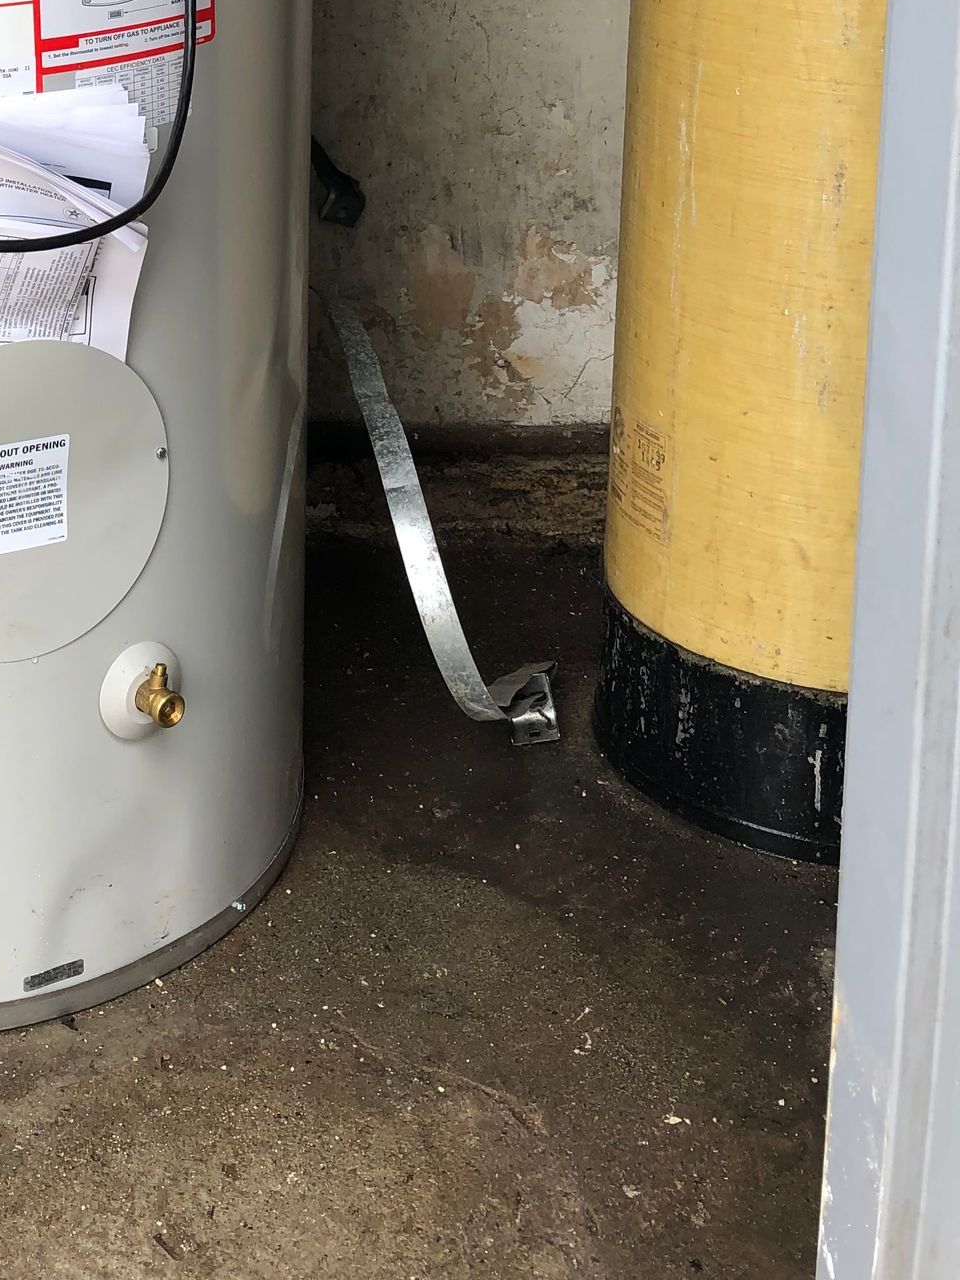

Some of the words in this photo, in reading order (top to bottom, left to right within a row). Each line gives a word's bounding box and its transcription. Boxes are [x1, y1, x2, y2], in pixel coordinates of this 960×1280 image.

[95, 36, 112, 44] TURN
[127, 30, 139, 38] GAS
[149, 21, 180, 34] APPLIANCE
[107, 65, 119, 73] CEC
[120, 59, 151, 70] EFFICIENCY
[152, 56, 165, 64] DATA
[14, 185, 38, 194] WATER
[40, 191, 66, 202] HEATER
[22, 439, 66, 454] OPENING
[0, 459, 34, 471] WARNING
